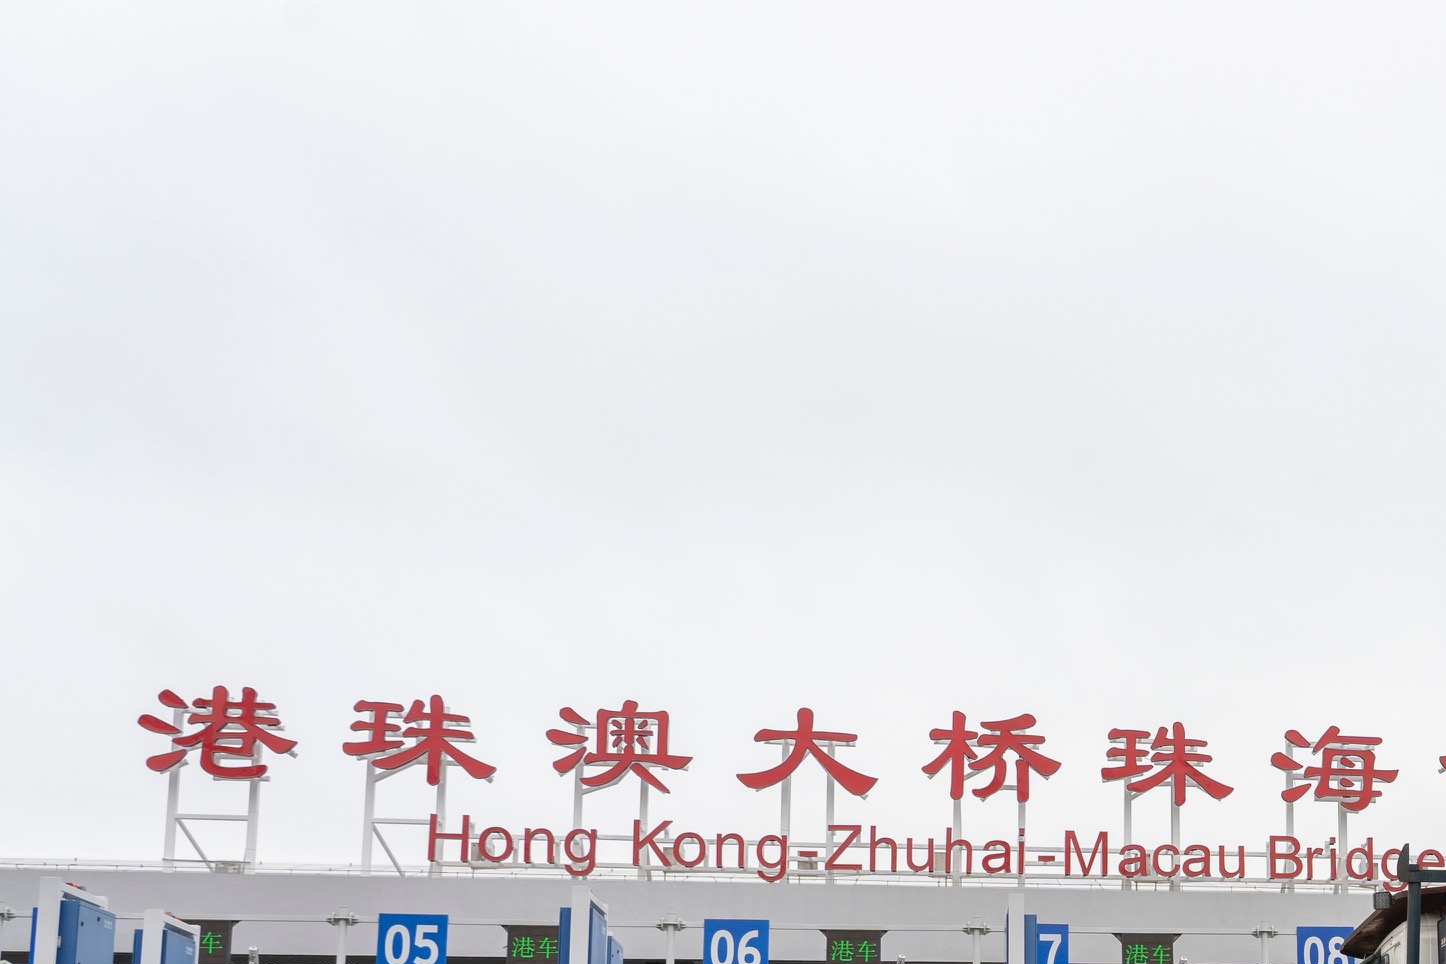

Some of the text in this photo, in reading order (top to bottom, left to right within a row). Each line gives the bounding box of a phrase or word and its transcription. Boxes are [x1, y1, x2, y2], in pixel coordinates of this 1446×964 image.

[428, 814, 1445, 892] Hong Kong-Zhuhai-Macau Bridge
[200, 931, 223, 954] 车
[511, 936, 558, 959] 港车
[830, 940, 878, 962] 港车
